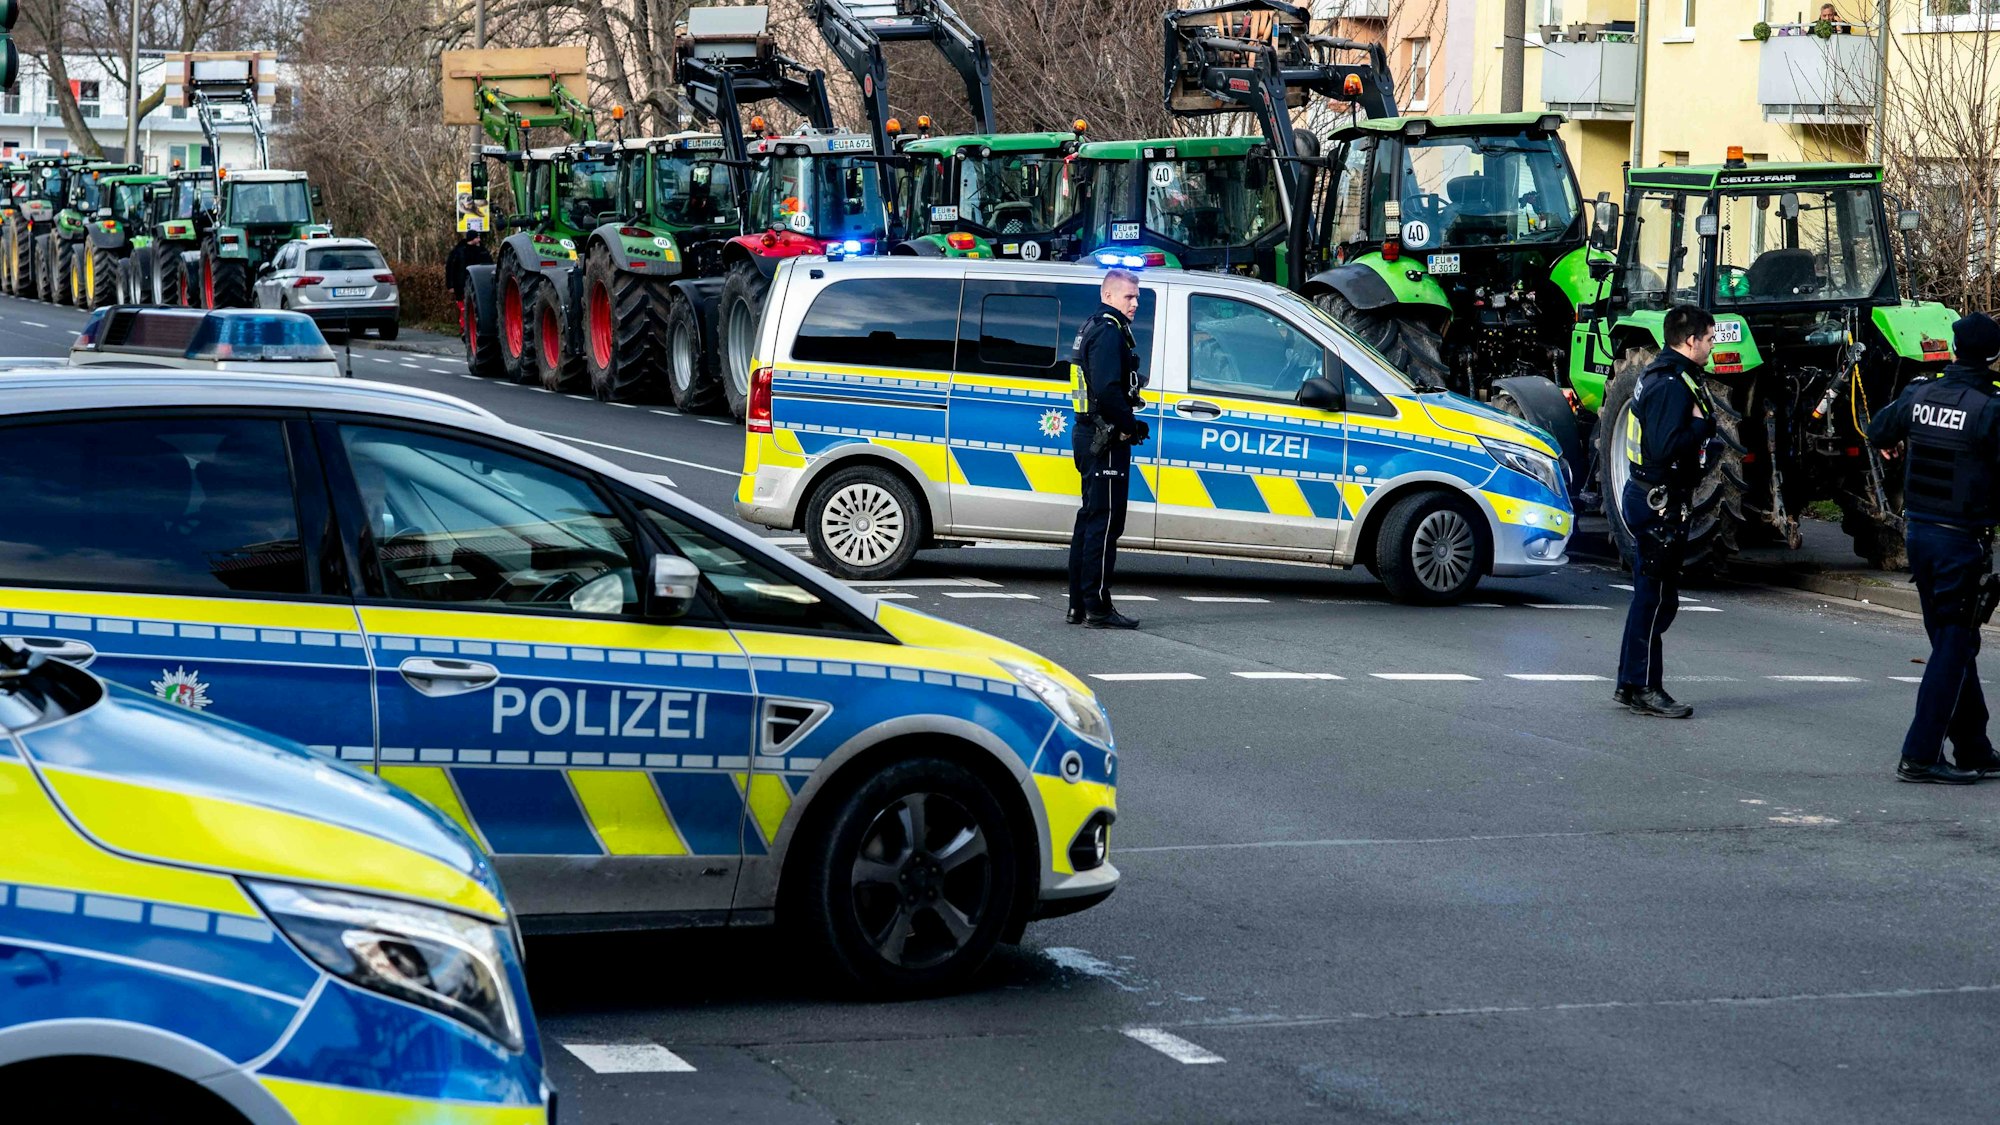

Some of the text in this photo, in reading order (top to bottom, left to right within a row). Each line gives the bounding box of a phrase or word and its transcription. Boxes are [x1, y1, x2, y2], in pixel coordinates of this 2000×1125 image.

[687, 140, 698, 148] EU
[833, 140, 844, 149] EU
[1155, 167, 1170, 183] 40
[1849, 171, 1873, 179] StarCab
[794, 215, 806, 228] 40
[1118, 224, 1128, 232] EU
[1408, 224, 1424, 242] 40
[1125, 231, 1138, 239] 662
[657, 238, 668, 247] 40
[1025, 244, 1036, 259] 40
[1435, 256, 1446, 265] EU
[1438, 264, 1459, 273] 3012
[1720, 331, 1738, 342] 390
[1595, 364, 1604, 374] DX
[1912, 403, 1967, 431] POLIZEI
[1201, 427, 1310, 459] POLIZEI
[492, 686, 708, 740] POLIZEI
